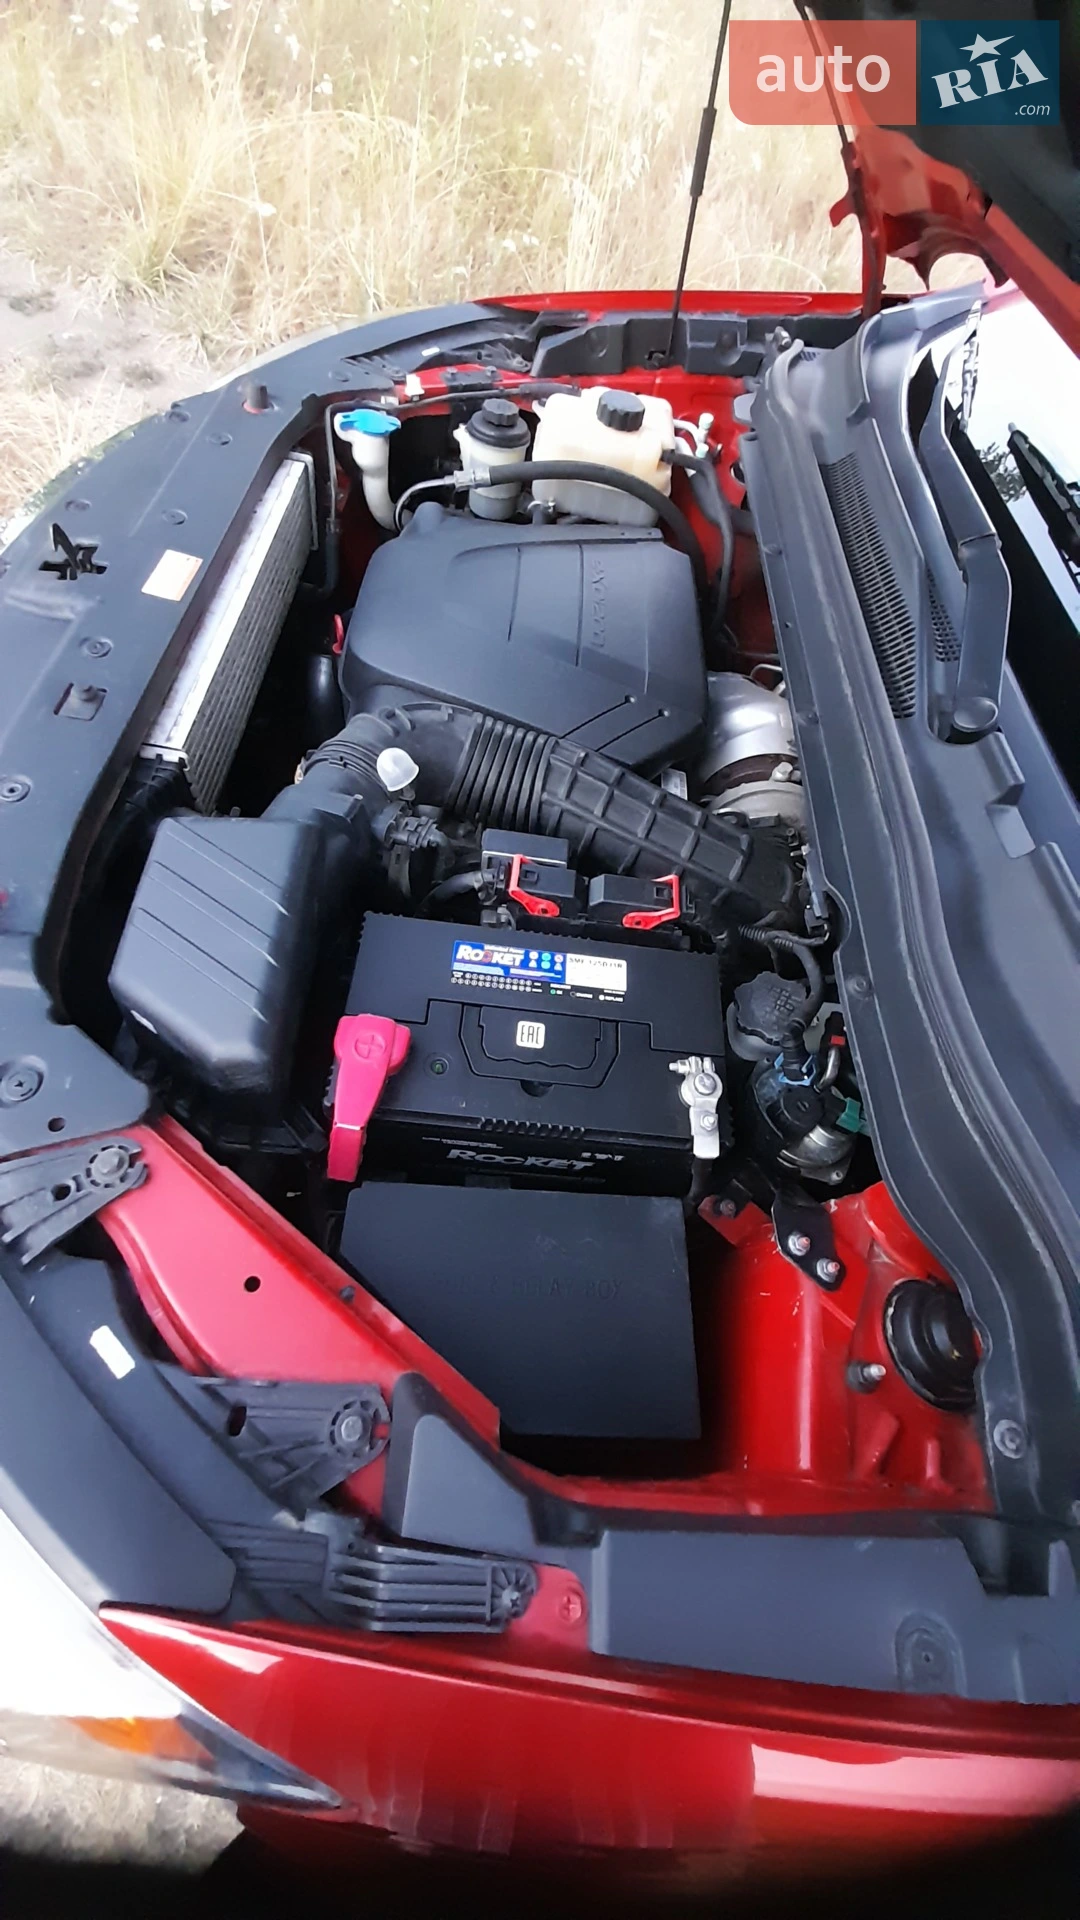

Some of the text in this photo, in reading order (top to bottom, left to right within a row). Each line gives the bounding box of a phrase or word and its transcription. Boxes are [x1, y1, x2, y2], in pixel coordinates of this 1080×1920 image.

[456, 944, 525, 967] ROCKET
[520, 1024, 541, 1045] EAC
[446, 1149, 595, 1170] ROCKET
